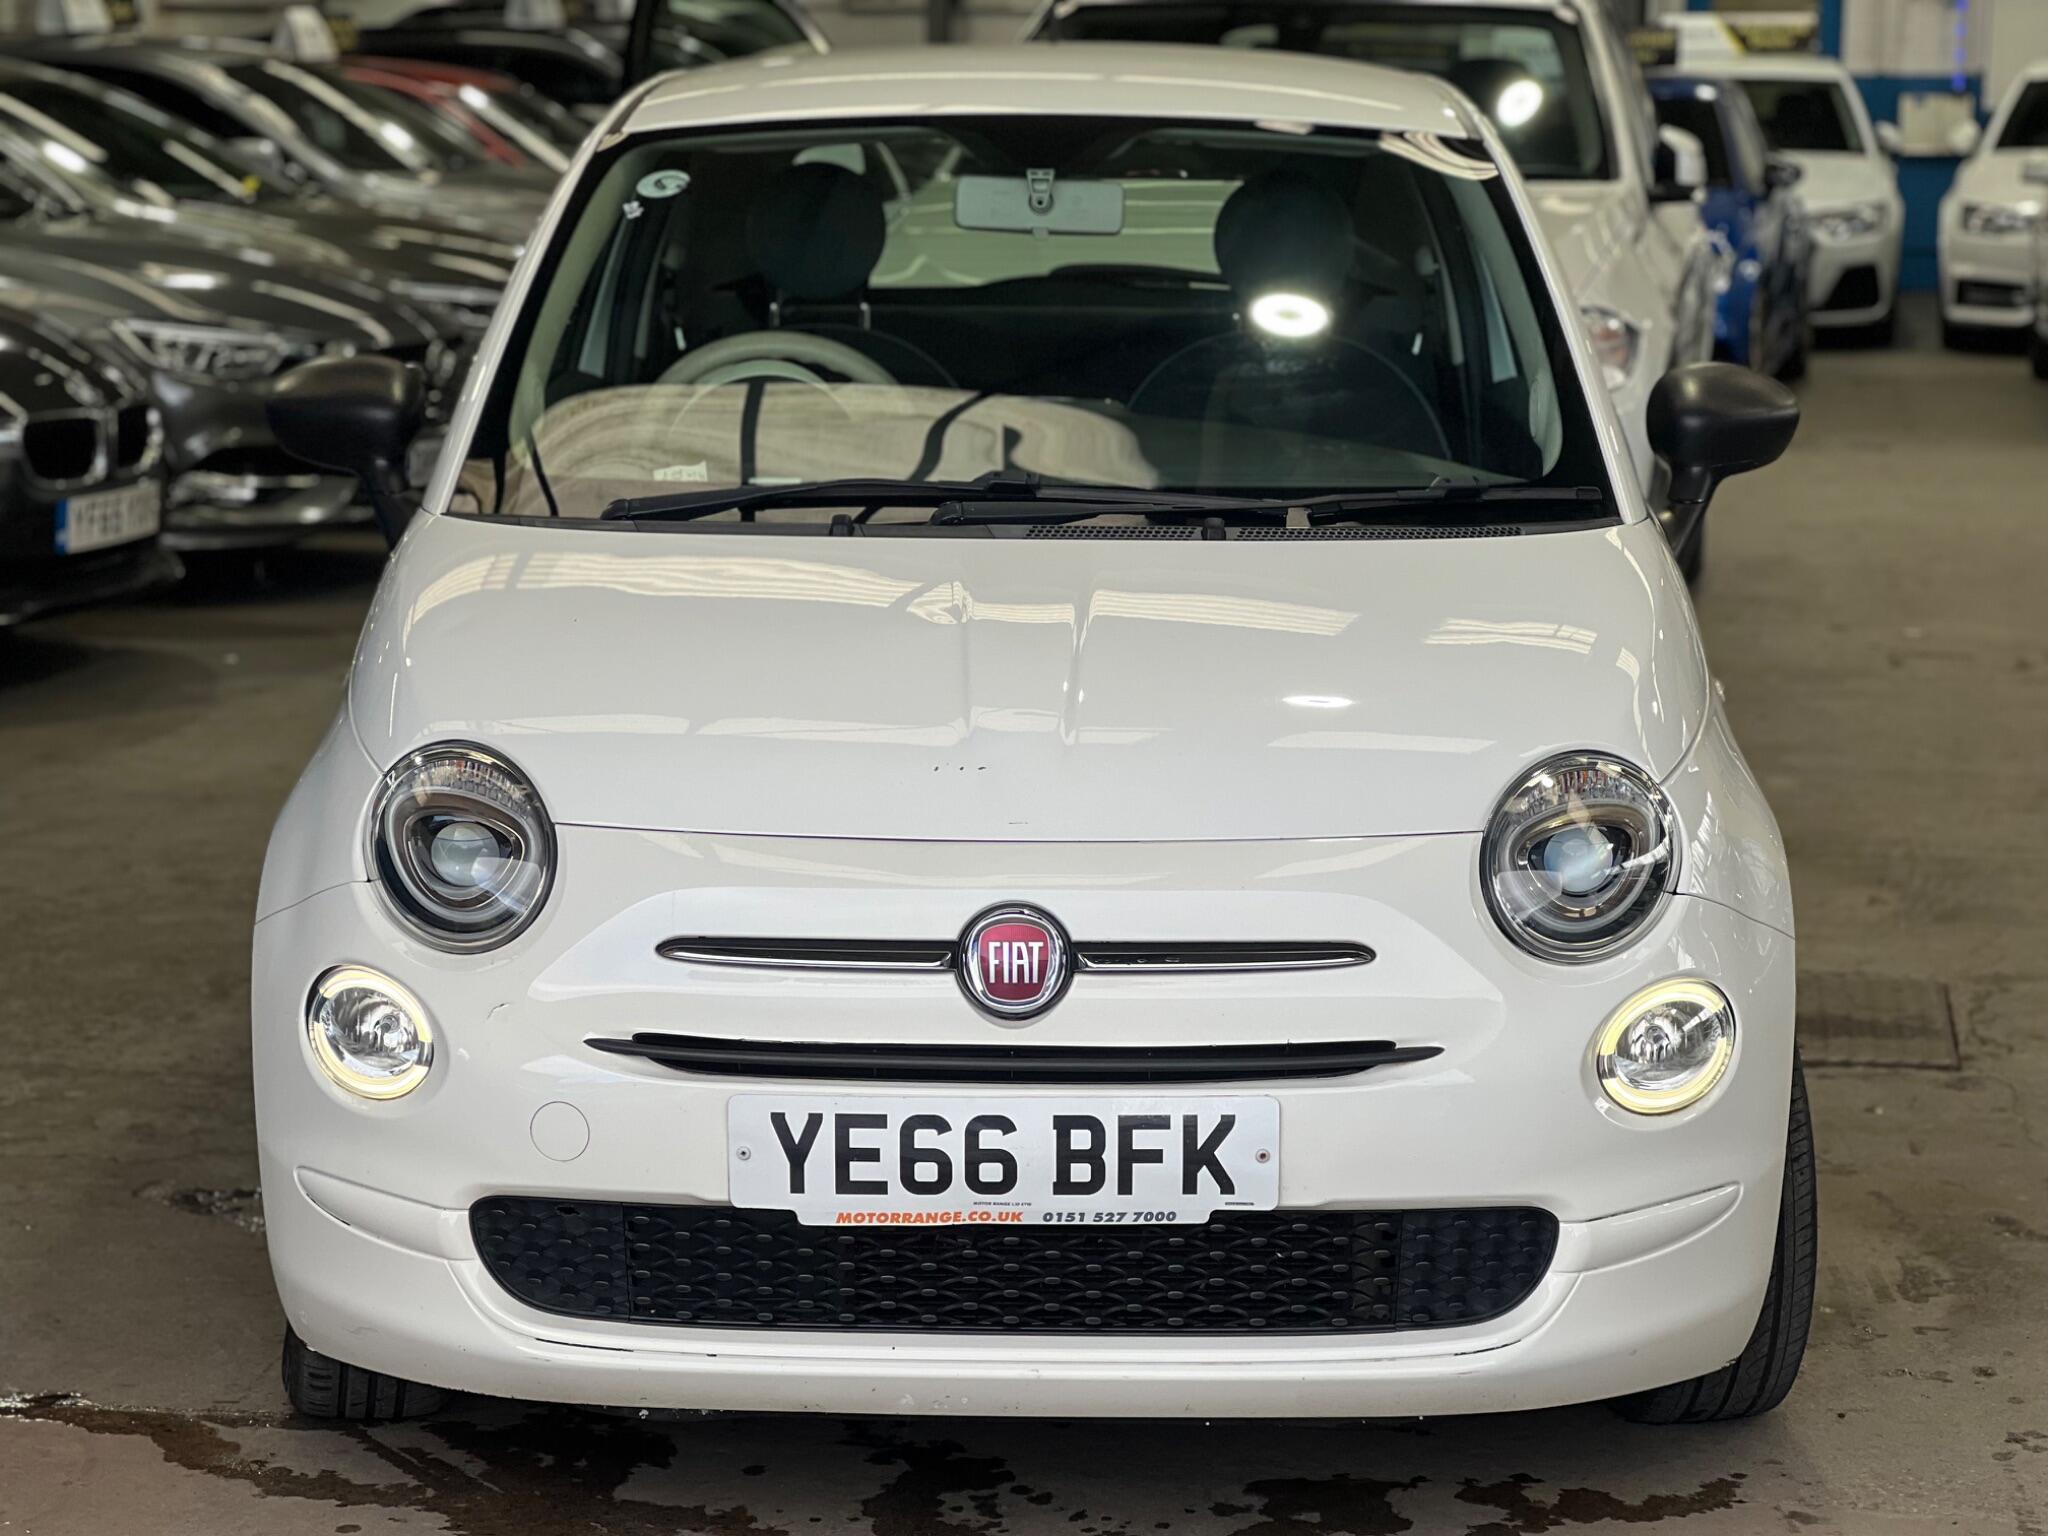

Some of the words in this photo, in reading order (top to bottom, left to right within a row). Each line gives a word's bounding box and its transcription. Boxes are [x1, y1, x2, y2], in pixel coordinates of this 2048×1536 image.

[988, 941, 1044, 984] FIAT
[770, 1112, 1018, 1196] YE66
[1052, 1113, 1236, 1197] BFK
[835, 1210, 1024, 1224] MOTORRANGE.CO.UK
[1042, 1212, 1086, 1223] 0151
[1092, 1212, 1128, 1223] 527
[1132, 1211, 1177, 1223] 7000
